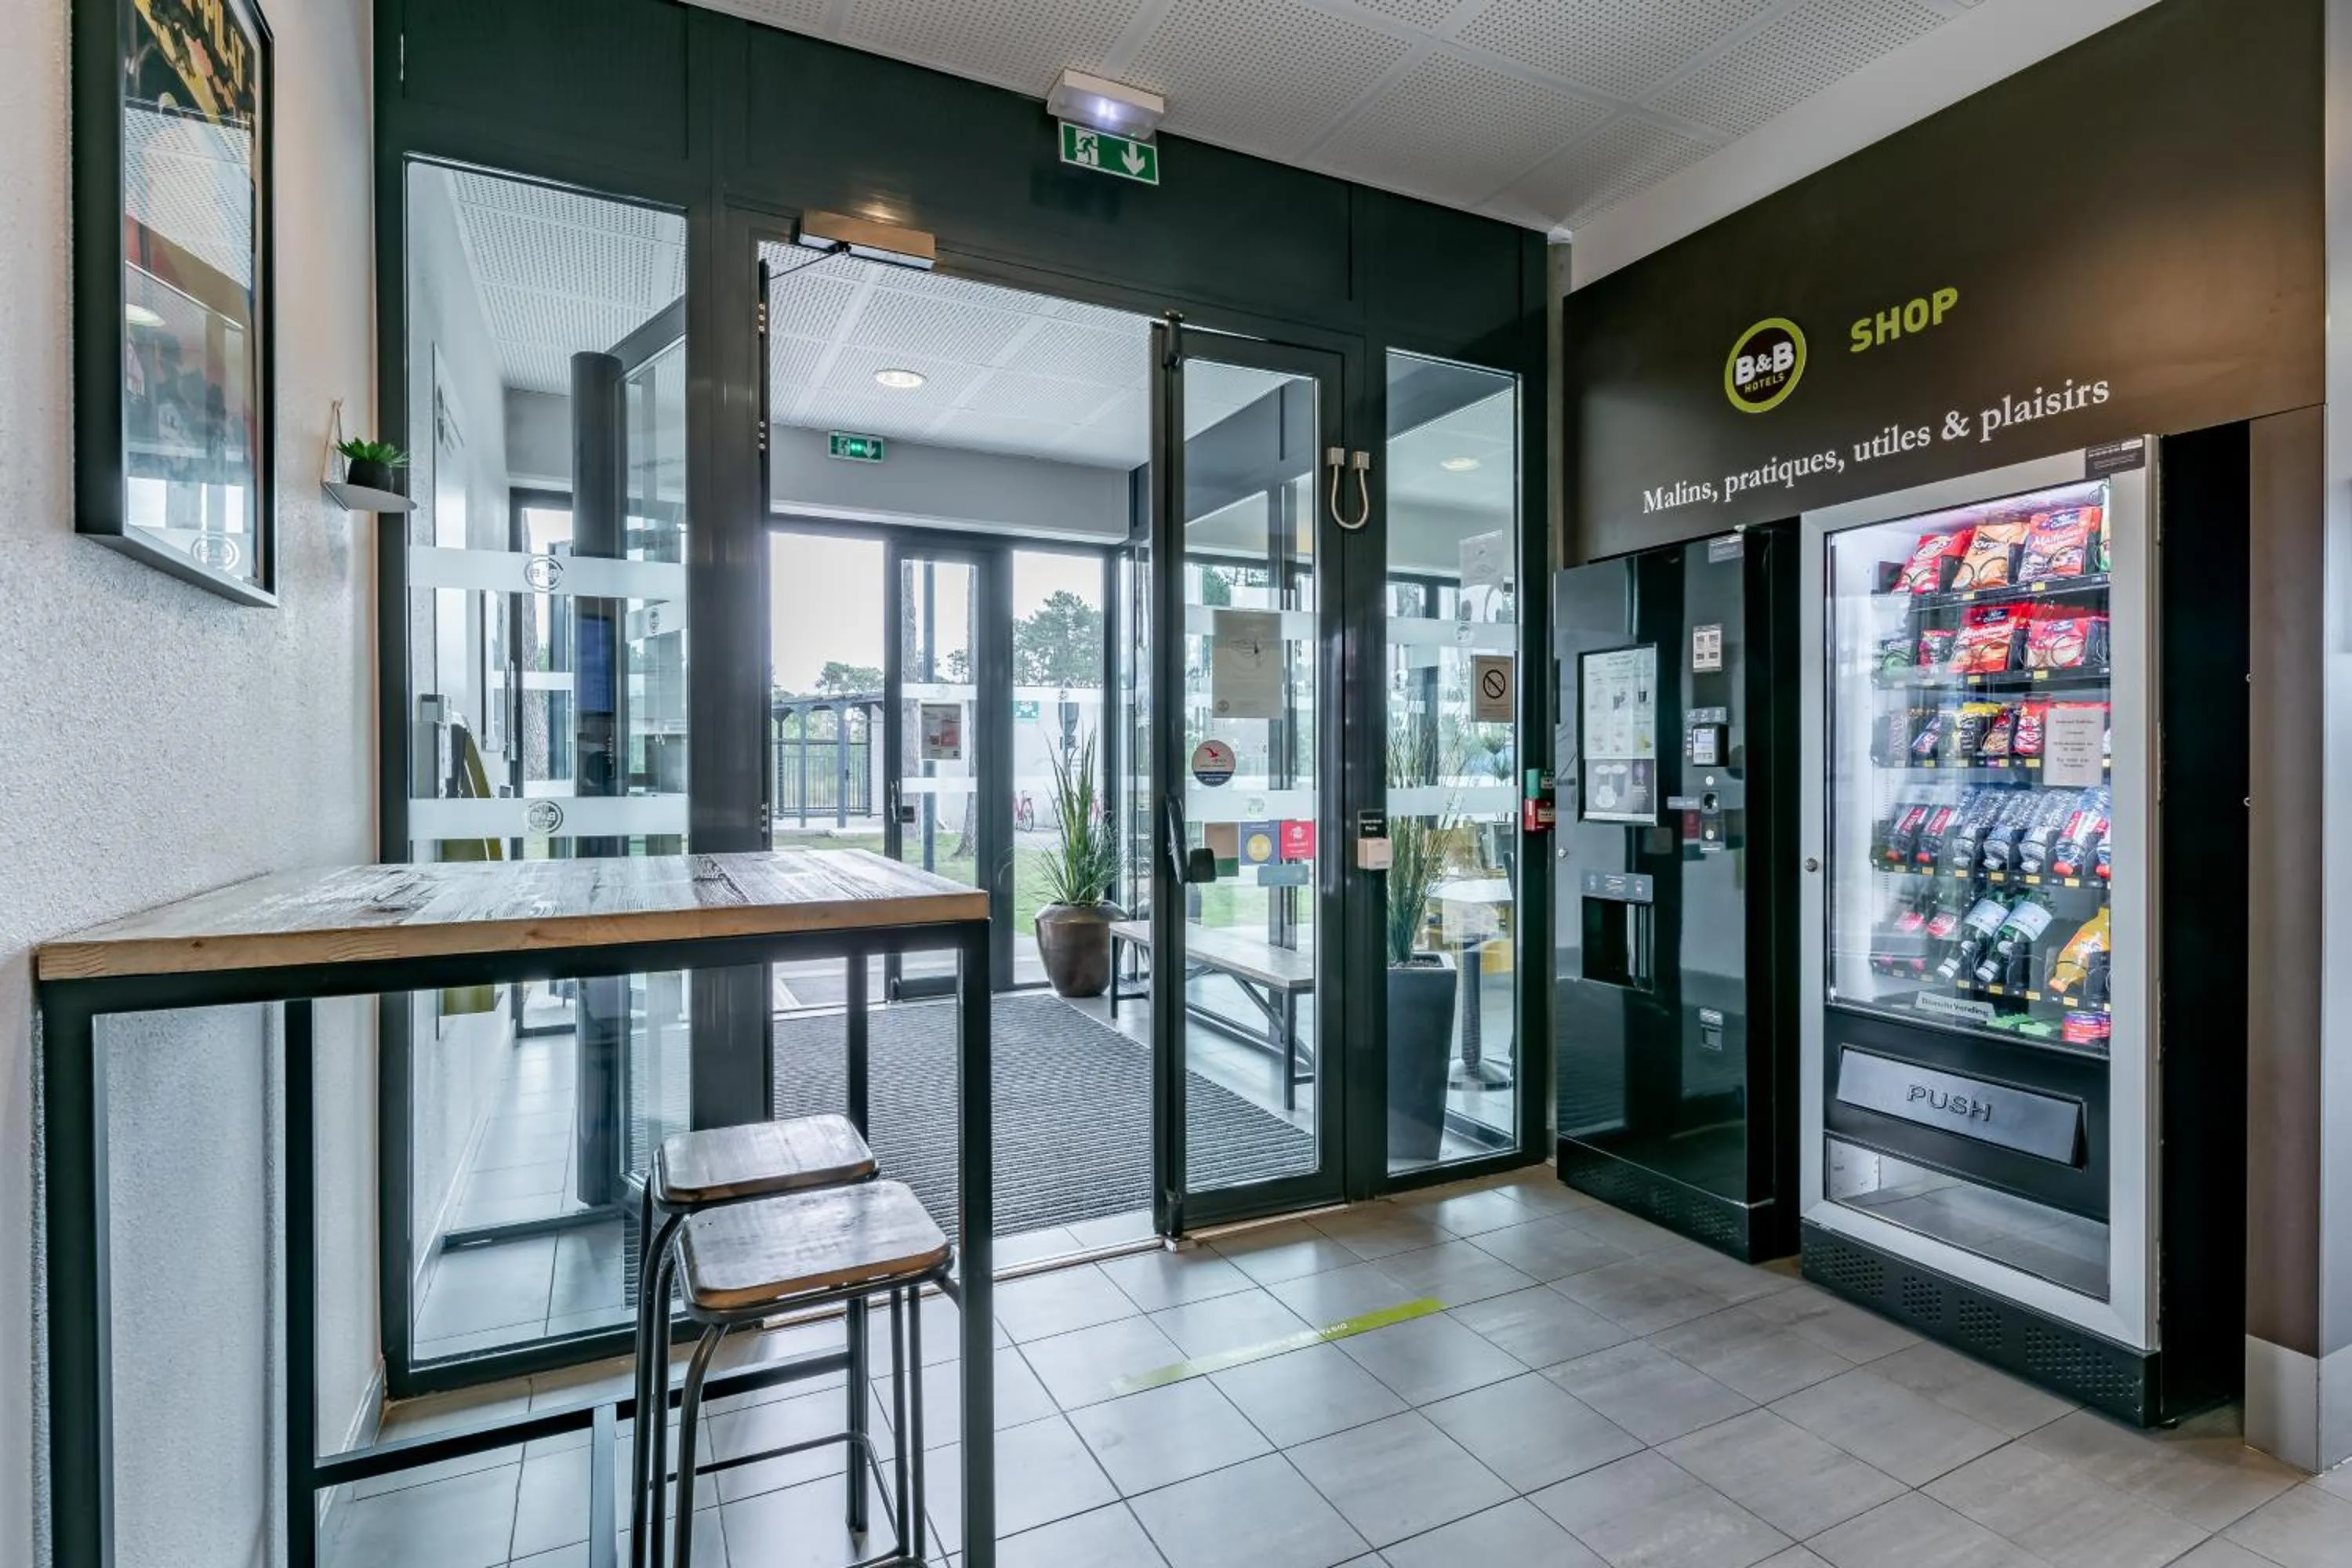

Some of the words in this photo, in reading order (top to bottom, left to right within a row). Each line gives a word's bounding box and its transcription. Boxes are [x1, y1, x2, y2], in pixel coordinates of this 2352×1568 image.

[1850, 288, 1958, 352] SHOP
[1735, 341, 1795, 386] B&B
[1744, 372, 1785, 394] HOTELS
[1642, 479, 1719, 516] Malins,
[1723, 450, 1845, 503] pratiques,
[1853, 423, 1931, 462] utiles
[1940, 410, 1970, 441] &
[1979, 378, 2111, 444] plaisirs
[1907, 1084, 1992, 1122] PUSH
